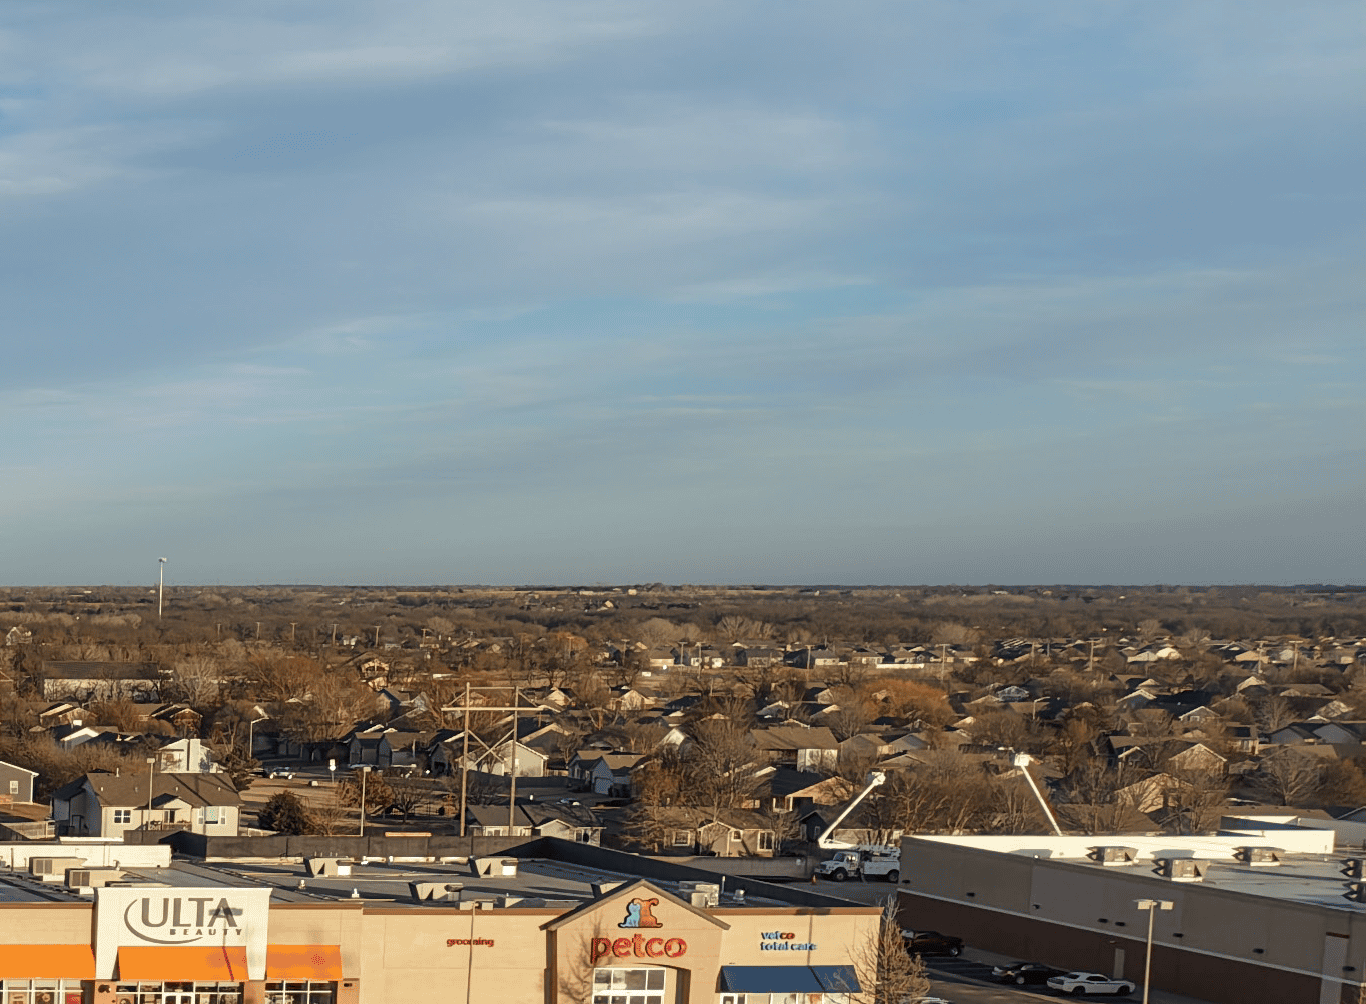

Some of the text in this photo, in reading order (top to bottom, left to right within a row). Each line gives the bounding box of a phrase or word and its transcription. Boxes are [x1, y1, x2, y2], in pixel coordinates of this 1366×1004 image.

[141, 897, 238, 928] ULTA
[169, 928, 243, 936] BEAUTY
[760, 930, 796, 940] vetco
[590, 933, 688, 965] petco
[759, 941, 789, 951] total
